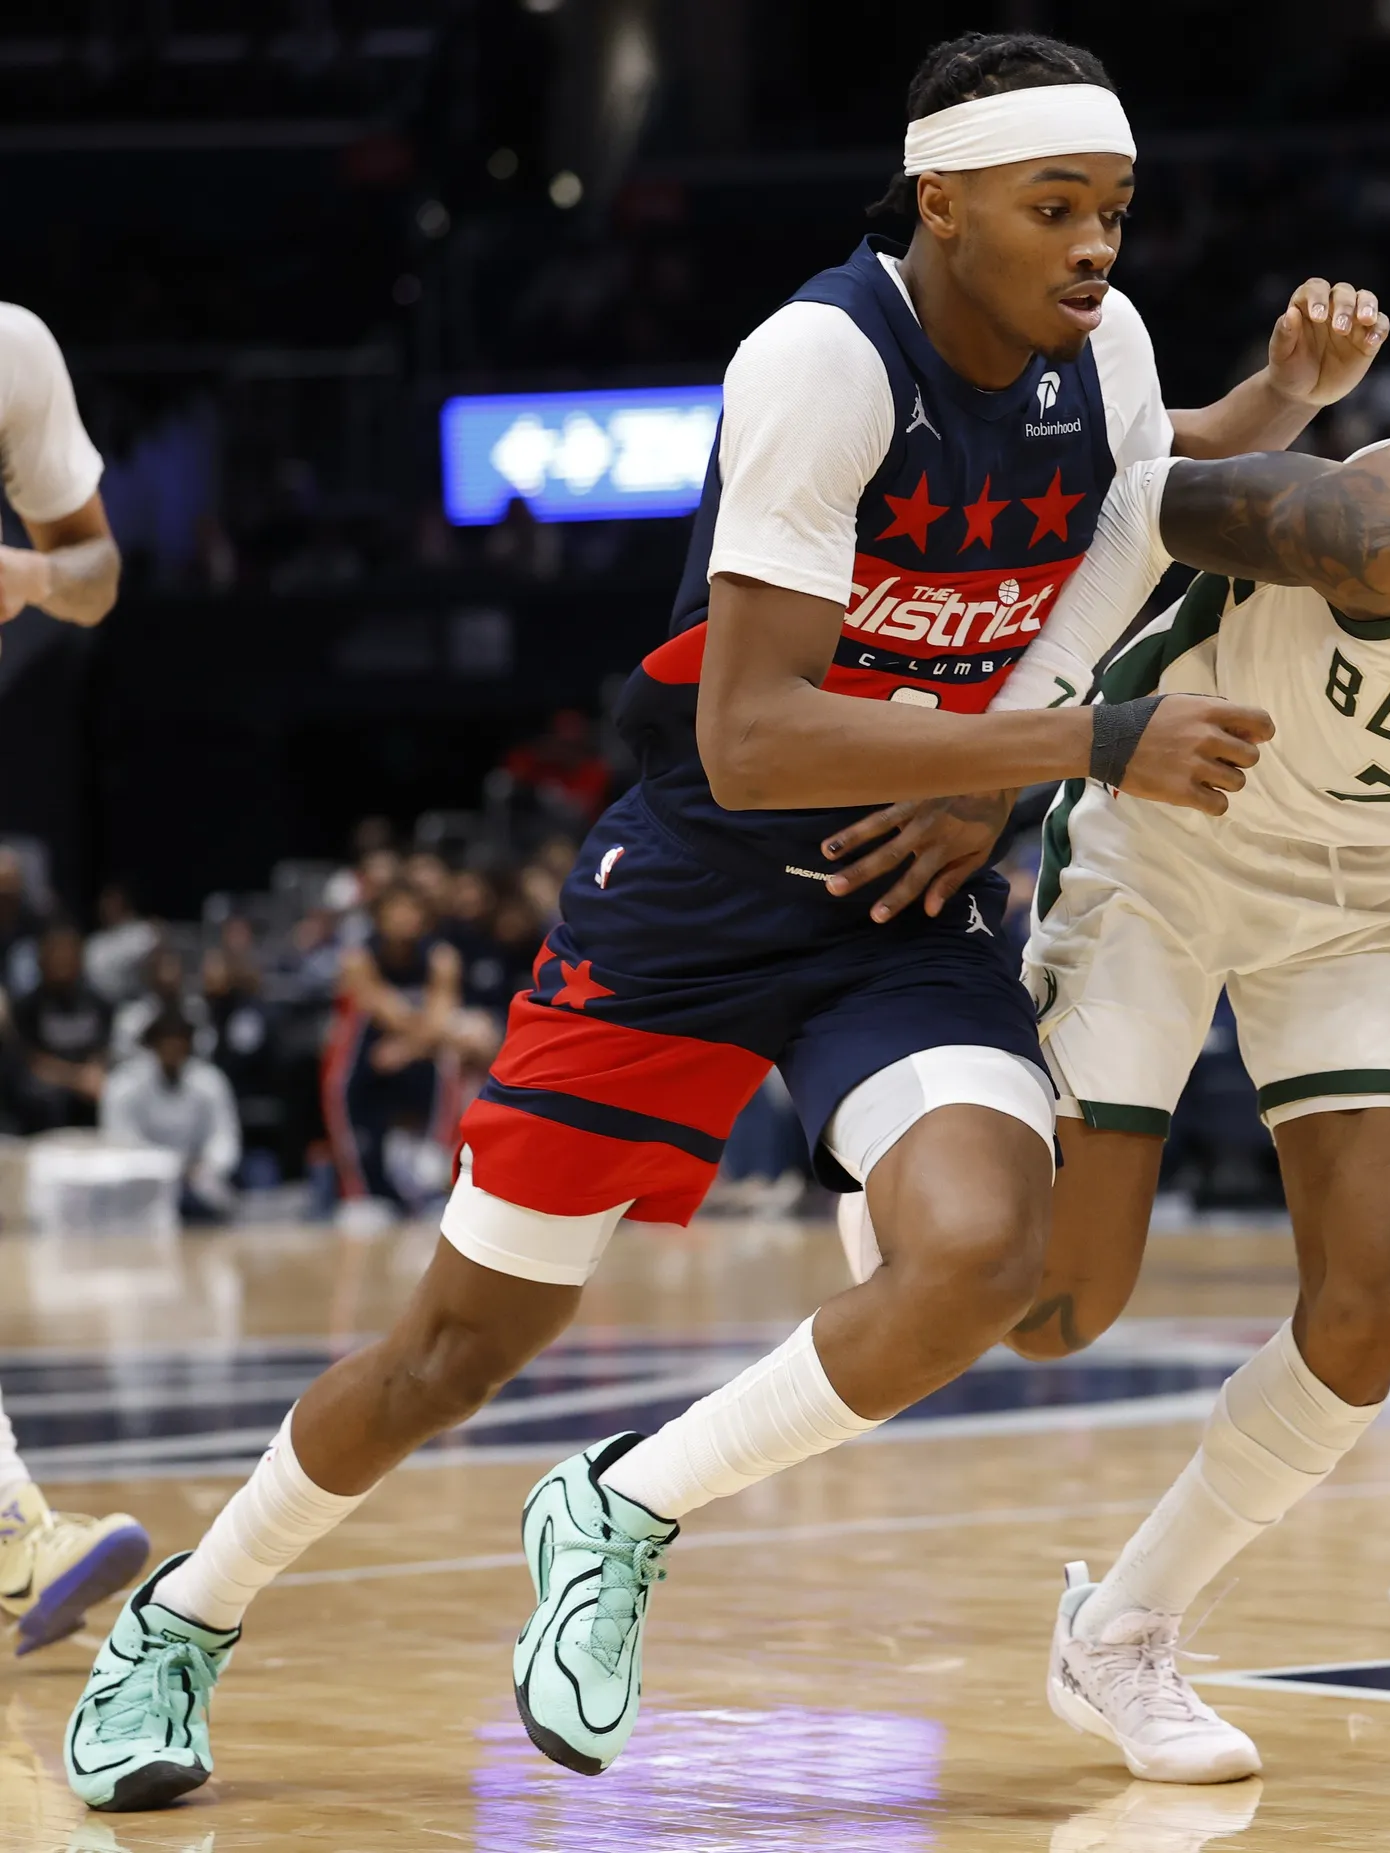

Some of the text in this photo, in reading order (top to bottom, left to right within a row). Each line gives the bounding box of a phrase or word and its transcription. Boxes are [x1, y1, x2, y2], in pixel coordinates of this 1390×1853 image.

[1025, 417, 1082, 437] Robinhood
[912, 585, 955, 603] THE
[843, 576, 1055, 648] district
